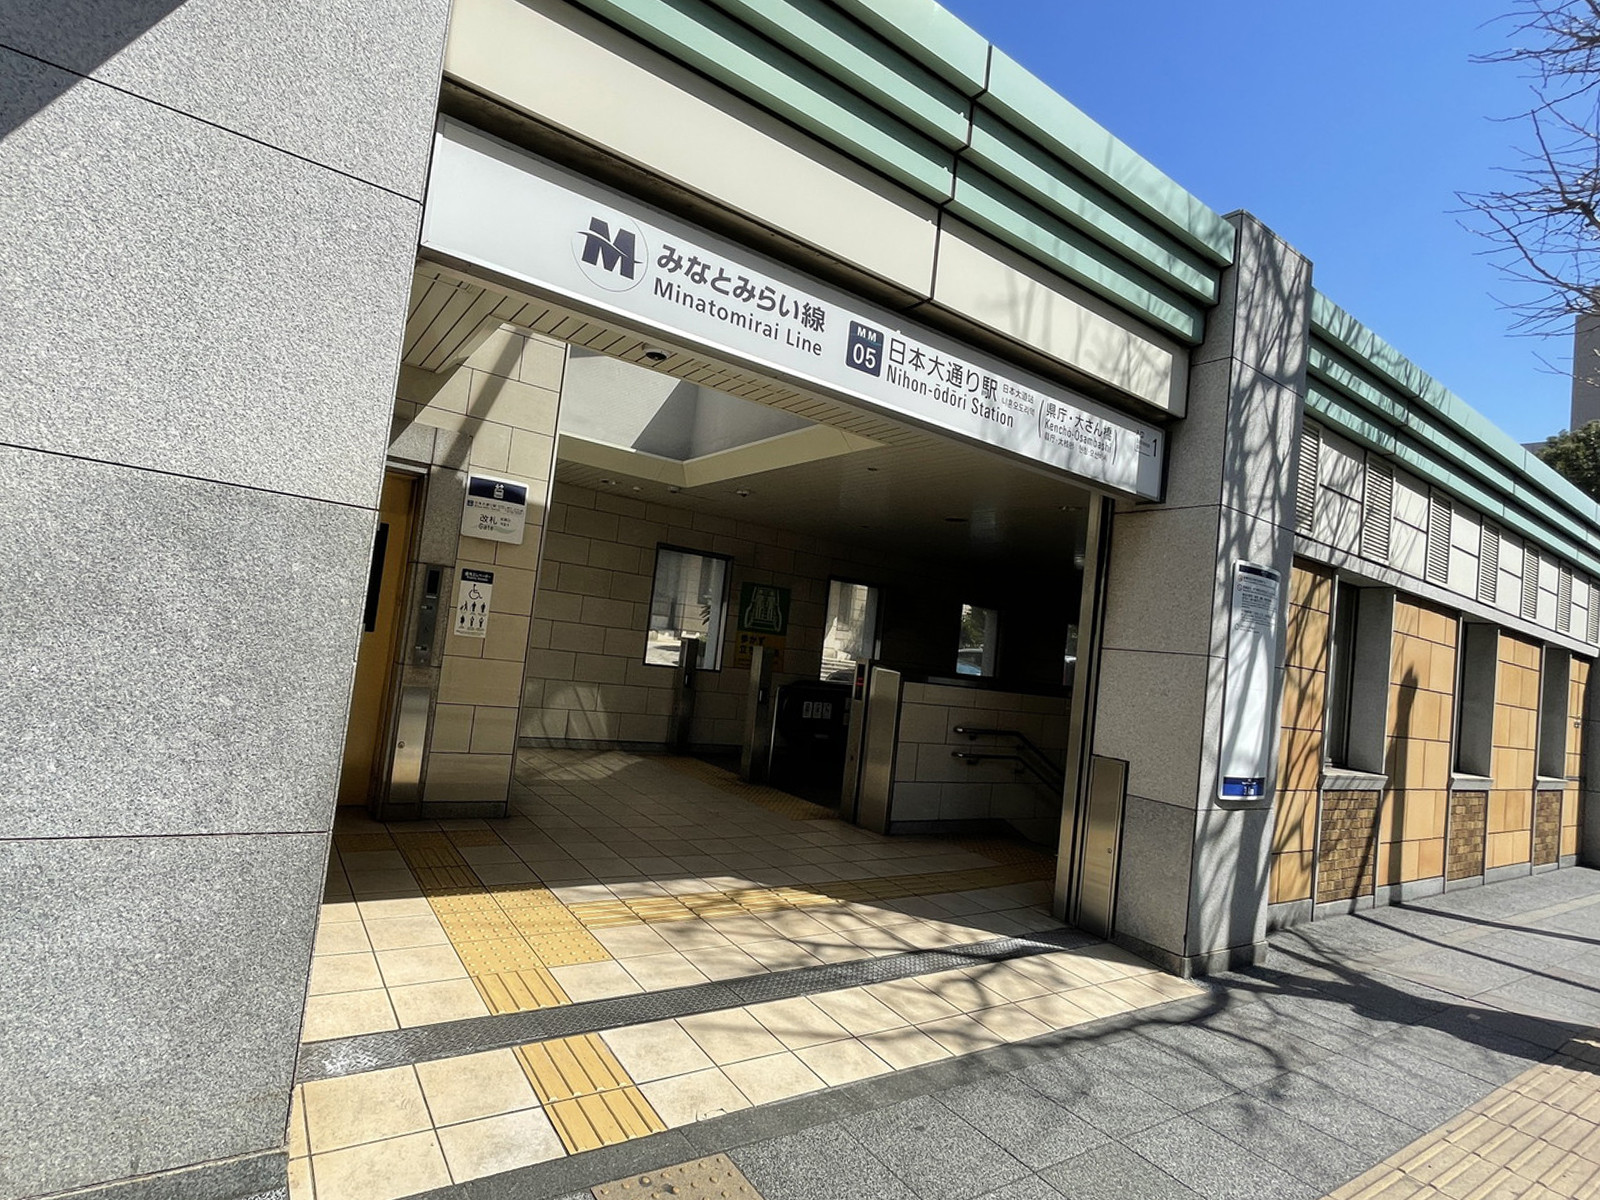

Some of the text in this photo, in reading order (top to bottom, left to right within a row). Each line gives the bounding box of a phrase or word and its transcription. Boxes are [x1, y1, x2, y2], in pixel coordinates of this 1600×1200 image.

[656, 244, 826, 333] みなとみらい線
[654, 277, 822, 356] Minatomirai Line
[857, 326, 877, 343] MM
[852, 343, 876, 369] 05
[889, 337, 998, 402] 日本大通り駅
[971, 396, 1014, 428] Station
[1152, 438, 1158, 458] 1
[478, 523, 494, 531] Gate
[479, 513, 498, 525] 改札
